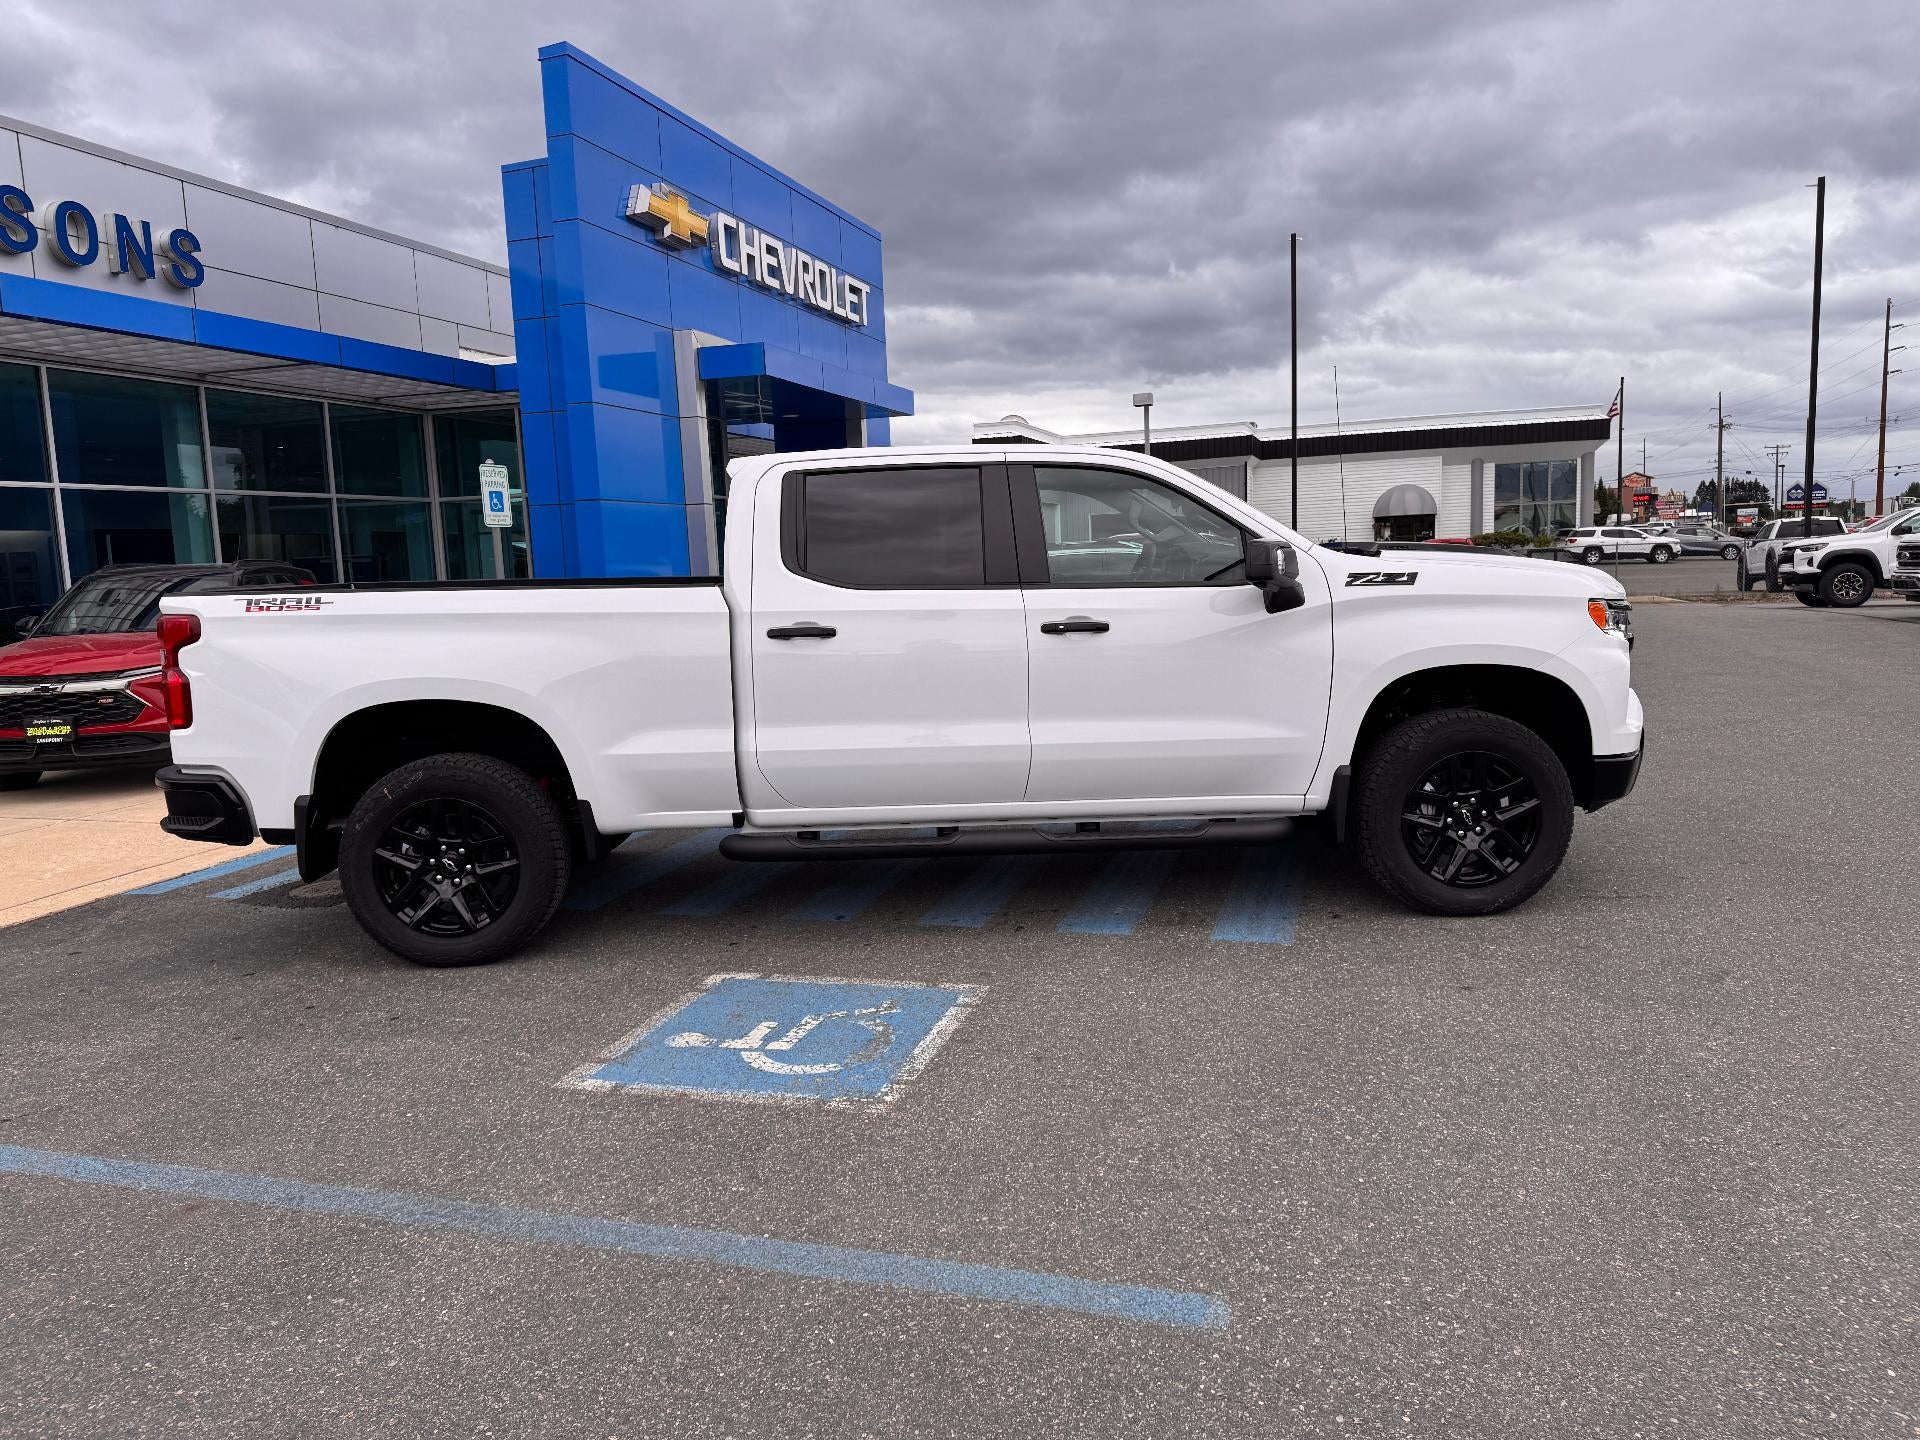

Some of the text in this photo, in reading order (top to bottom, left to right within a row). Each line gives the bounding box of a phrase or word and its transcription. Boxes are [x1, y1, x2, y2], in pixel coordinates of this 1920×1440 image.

[0, 185, 205, 288] SONS
[710, 211, 870, 326] CHEVROLET
[482, 469, 506, 479] RESERVED
[484, 480, 506, 489] PARKING
[1345, 572, 1418, 587] Z71
[234, 597, 334, 606] TRAIL
[245, 604, 321, 613] BOSS
